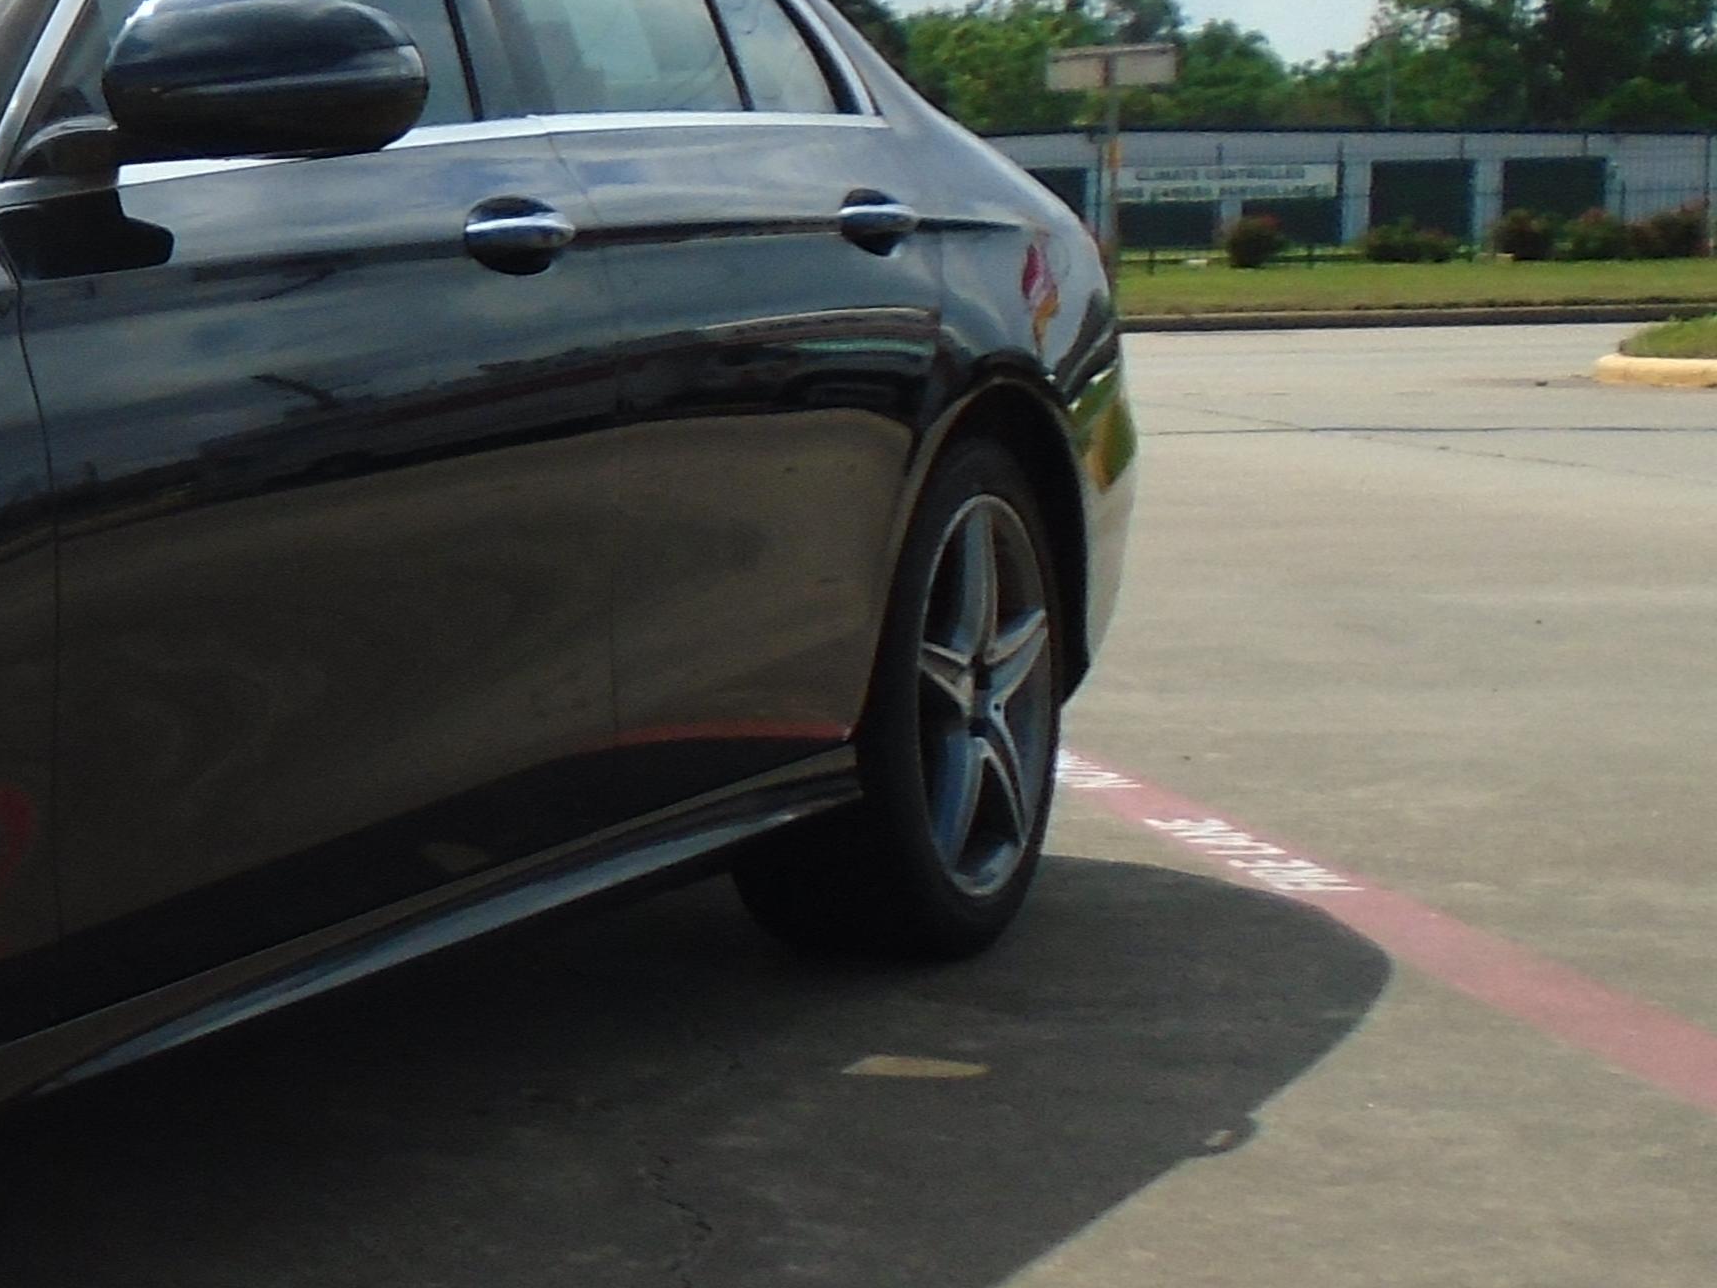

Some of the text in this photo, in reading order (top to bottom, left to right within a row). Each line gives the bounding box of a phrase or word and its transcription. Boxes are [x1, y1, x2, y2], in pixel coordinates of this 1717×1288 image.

[1135, 166, 1306, 181] CLIMATE CONTROLLED
[1143, 817, 1287, 855] LANE
[1228, 858, 1365, 892] FIRE
